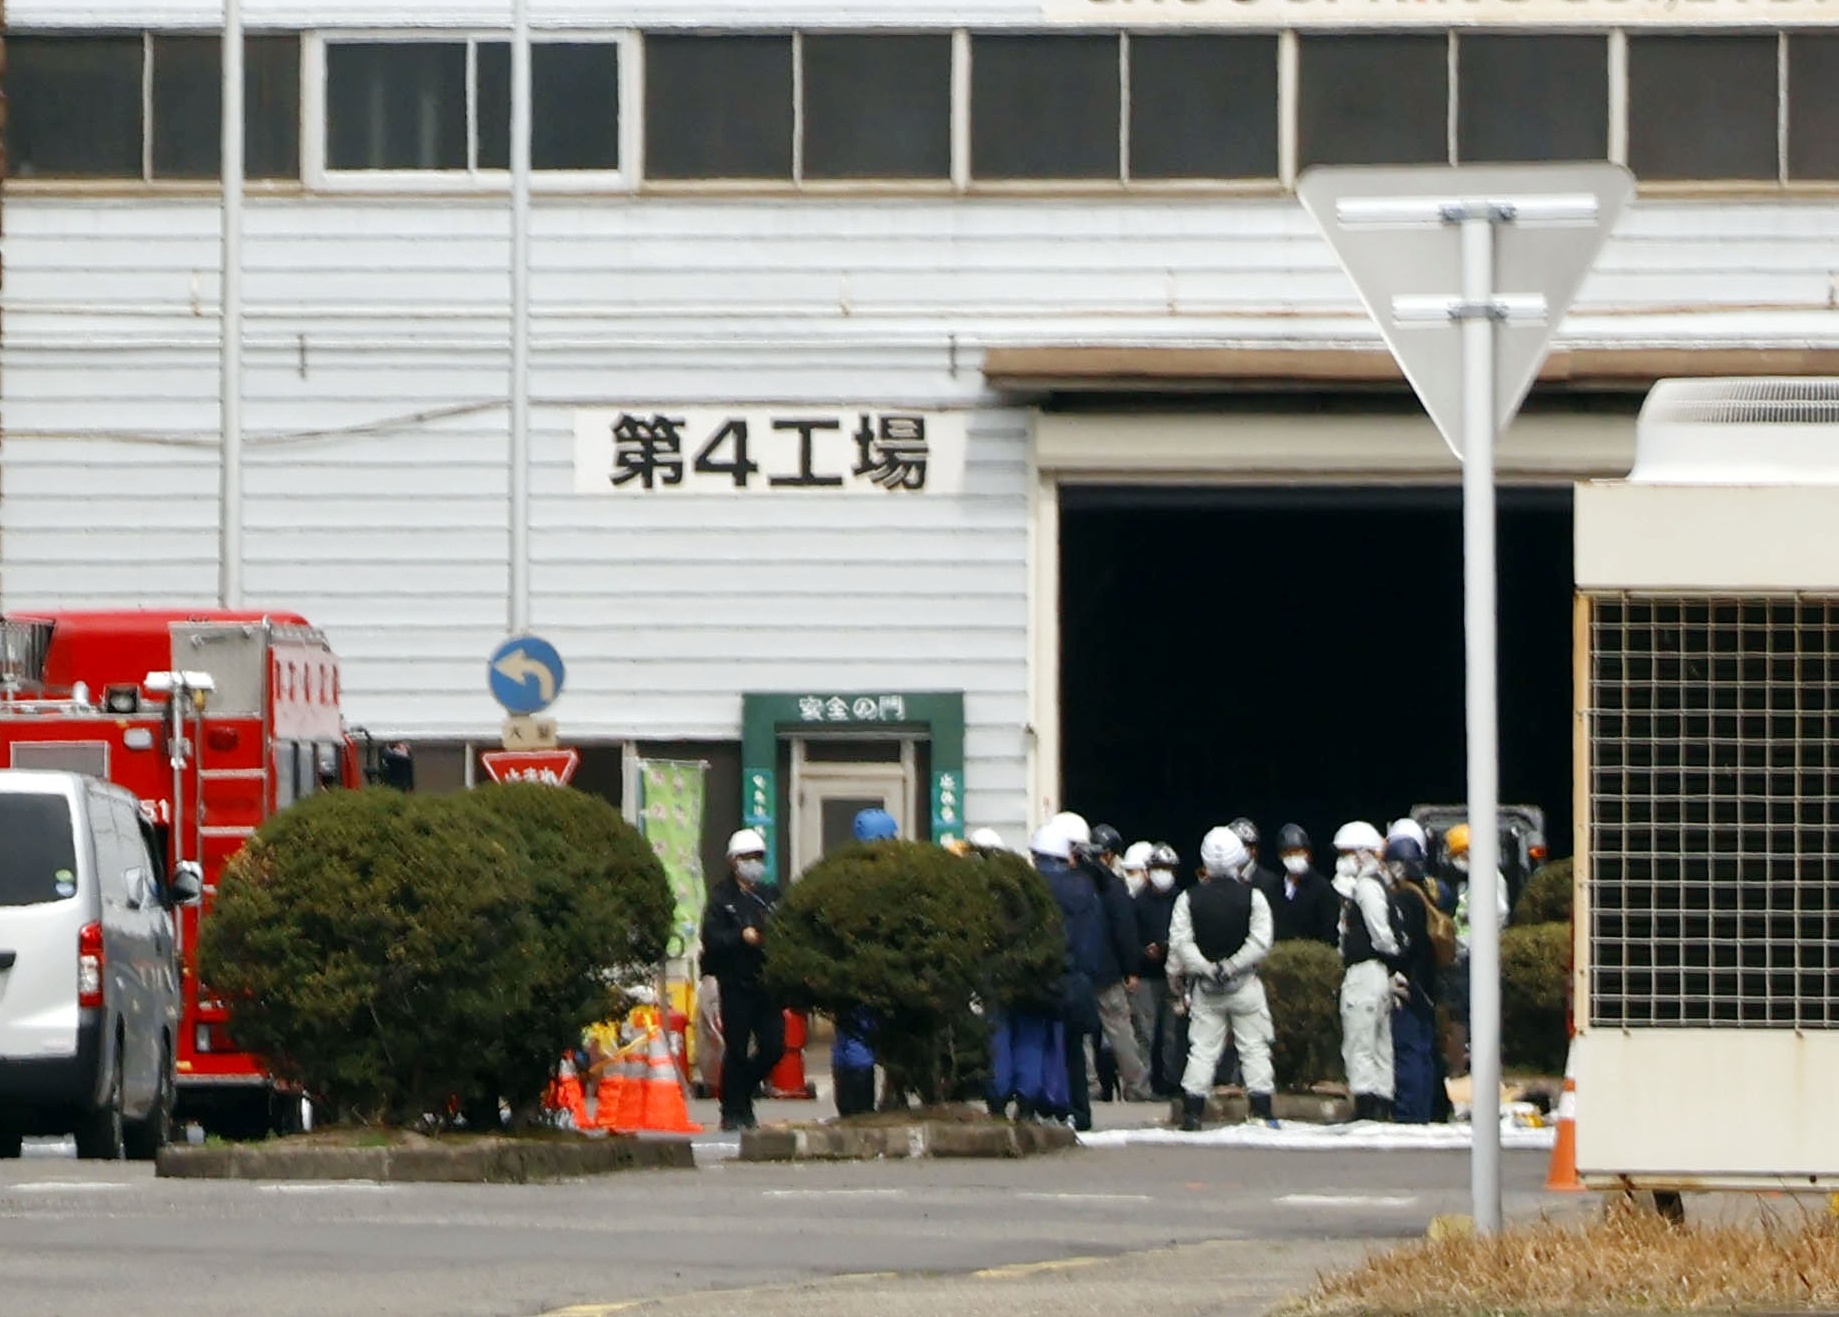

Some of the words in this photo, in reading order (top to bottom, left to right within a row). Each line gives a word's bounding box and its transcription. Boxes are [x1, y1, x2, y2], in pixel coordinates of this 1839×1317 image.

[609, 413, 930, 490] 第4工場
[798, 695, 906, 721] 安全の門
